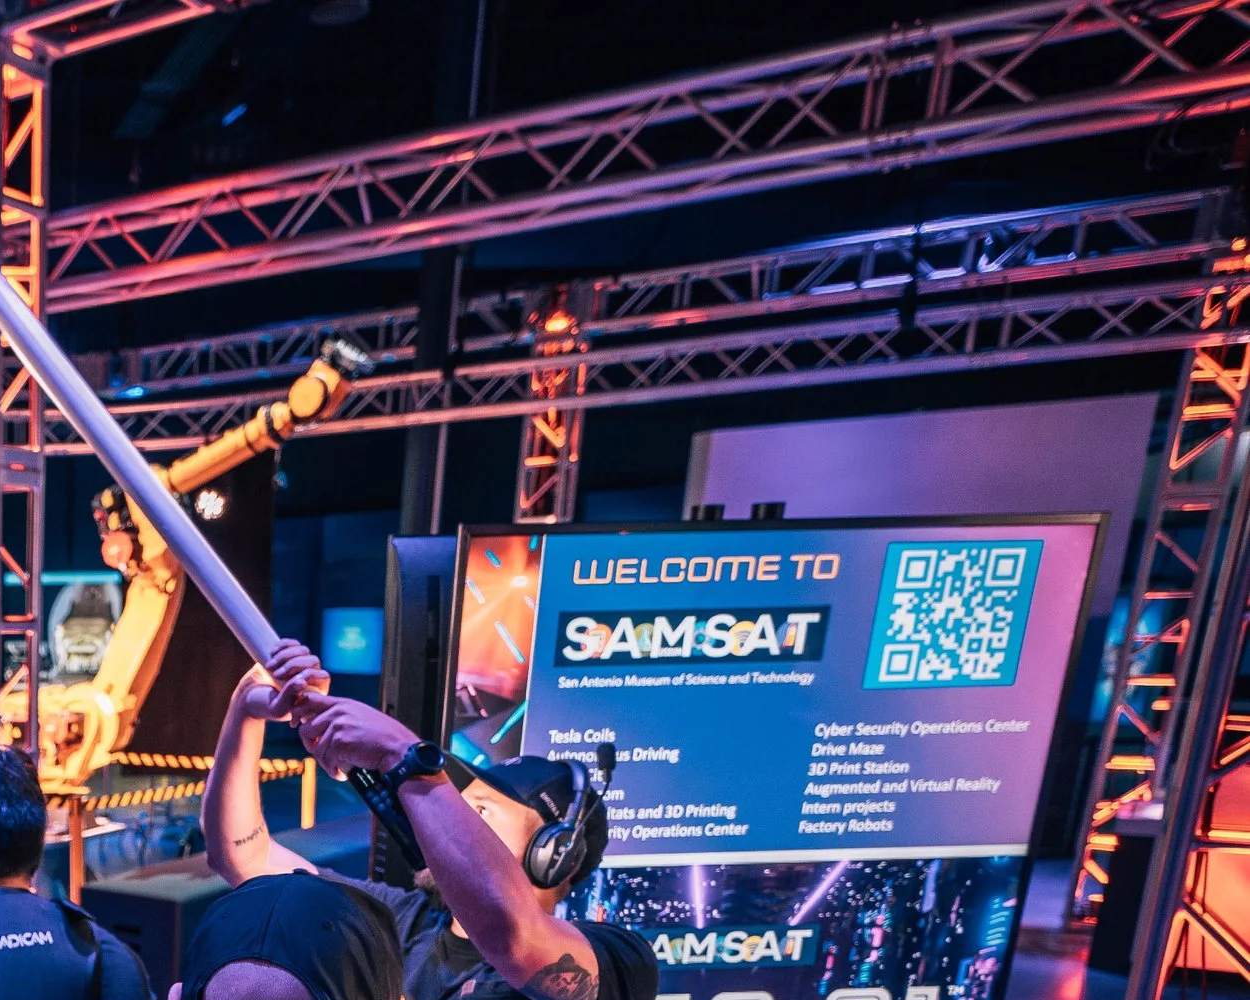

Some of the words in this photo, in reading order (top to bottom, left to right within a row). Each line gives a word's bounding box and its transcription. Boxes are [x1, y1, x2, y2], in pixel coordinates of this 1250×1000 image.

[573, 555, 781, 585] WELCOME
[790, 554, 841, 581] TO
[562, 613, 821, 661] SAMSAT
[558, 676, 578, 689] San
[580, 675, 622, 688] Antonio
[624, 674, 670, 687] Museum
[672, 673, 684, 686] of
[685, 673, 726, 686] Science
[728, 672, 749, 685] and
[752, 671, 814, 686] Technology
[549, 729, 582, 744] Tesla
[584, 728, 616, 743] Coils
[814, 722, 854, 739] Cyber
[855, 720, 909, 738] Security
[910, 719, 983, 737] Operations
[985, 718, 1030, 733] Center
[547, 749, 630, 763] Autonous
[632, 747, 680, 763] Driving
[811, 743, 847, 757] Drive
[849, 742, 885, 756] Maze
[808, 762, 827, 776] 3D
[829, 761, 861, 776] Print
[863, 760, 910, 775] Station
[803, 779, 881, 798] Augmented
[882, 778, 908, 794] and
[909, 777, 953, 793] Virtual
[955, 776, 1001, 794] Reality
[607, 806, 635, 820] itats
[636, 804, 663, 819] and
[664, 804, 684, 819] 3D
[685, 803, 737, 820] Printing
[801, 800, 841, 815] Intern
[842, 799, 896, 816] projects
[608, 825, 630, 842] rity
[631, 823, 703, 842] Operations
[704, 822, 749, 837] Center
[798, 820, 847, 835] Factory
[848, 818, 894, 833] Robots
[651, 929, 814, 965] AMSAT
